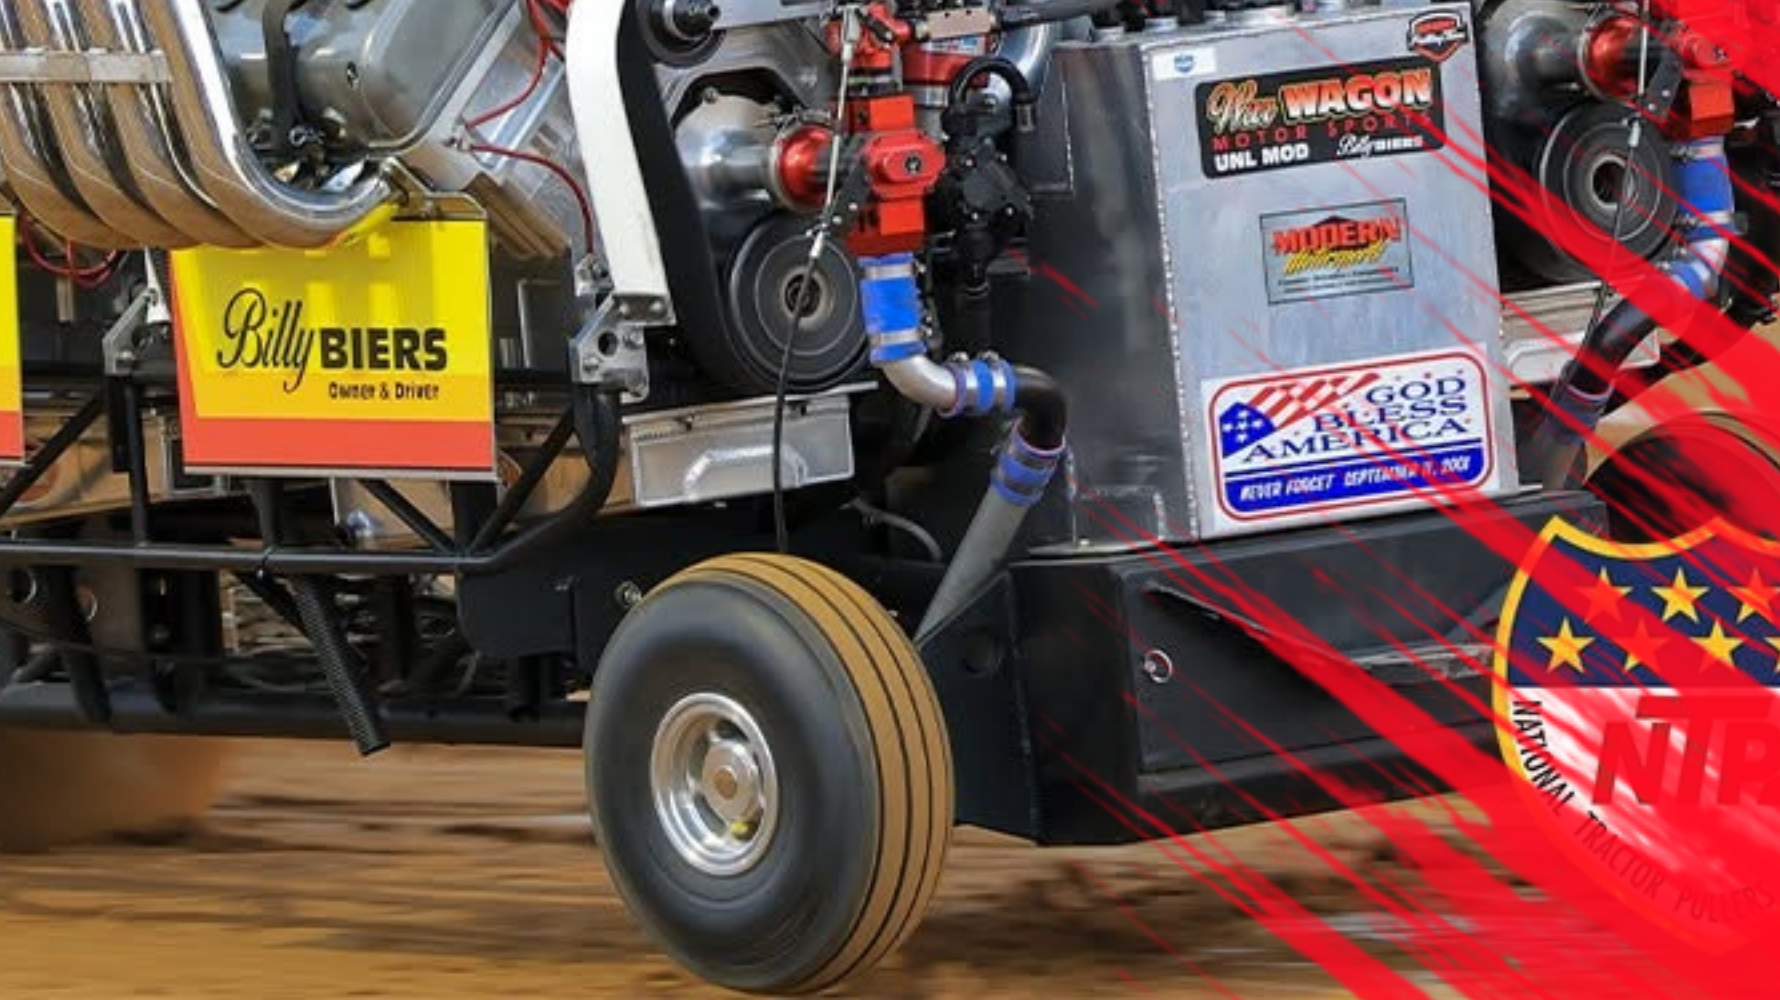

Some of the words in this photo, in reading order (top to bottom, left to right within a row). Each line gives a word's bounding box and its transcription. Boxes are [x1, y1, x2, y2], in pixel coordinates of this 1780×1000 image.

[1279, 68, 1431, 124] WAGON
[1212, 128, 1308, 149] MOTOR
[1327, 113, 1432, 137] SPORTS
[1215, 150, 1258, 171] UNL
[1262, 143, 1309, 164] MOD
[1272, 212, 1402, 255] MODERN
[217, 288, 315, 394] Billy
[321, 328, 448, 371] BIERS
[328, 381, 375, 399] Owner
[395, 381, 440, 400] Driver
[1366, 376, 1467, 406] GOD
[1314, 396, 1468, 433] BLESS
[1243, 417, 1469, 463] AMERICA
